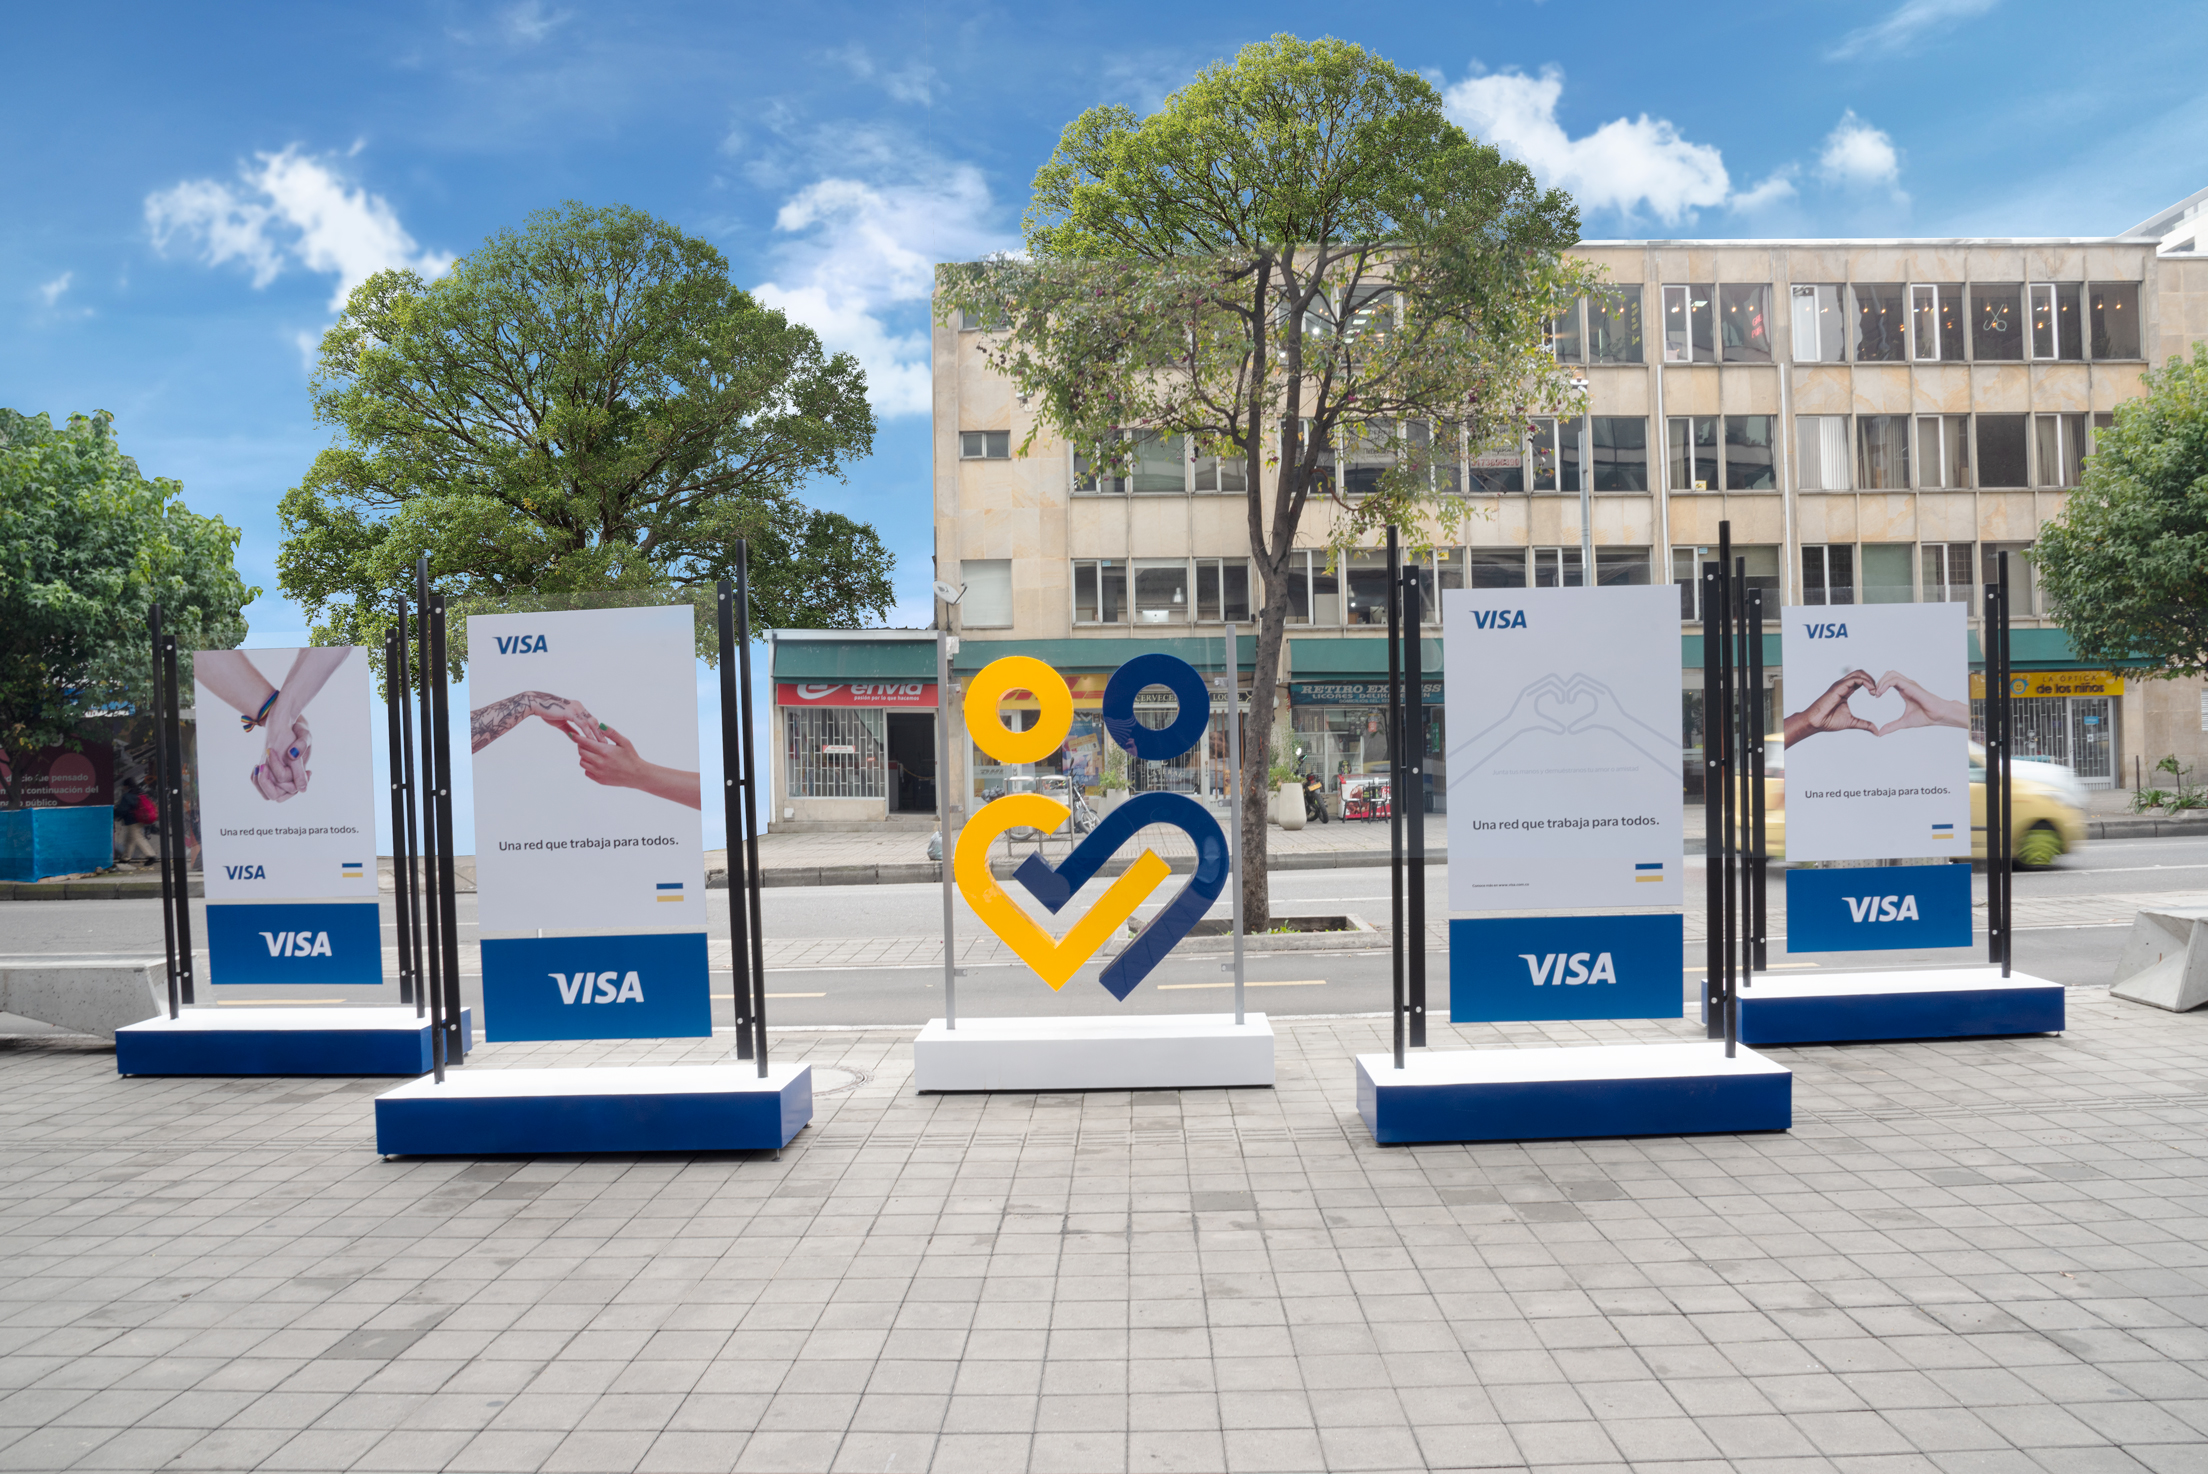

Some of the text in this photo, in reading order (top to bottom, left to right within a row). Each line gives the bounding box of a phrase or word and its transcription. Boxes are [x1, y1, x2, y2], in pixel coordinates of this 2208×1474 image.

[1469, 610, 1527, 629] VISA
[1802, 623, 1848, 639] VISA
[492, 634, 548, 654] VISA
[1301, 684, 1442, 694] RETIRO EXSS
[2036, 682, 2105, 694] de los niños
[51, 774, 88, 783] pensado
[27, 786, 83, 794] continuación
[1805, 786, 1950, 799] Una red que trabaja para todos.
[1473, 816, 1659, 830] Una red que trabaja para todos.
[275, 827, 307, 836] trabaja
[309, 828, 328, 836] para
[499, 836, 679, 851] Una red que trabaja para todos.
[223, 865, 266, 880] VISA
[1842, 894, 1919, 923] VISA
[258, 931, 332, 957] VISA
[1518, 952, 1617, 986] VISA
[548, 971, 645, 1005] VISA
